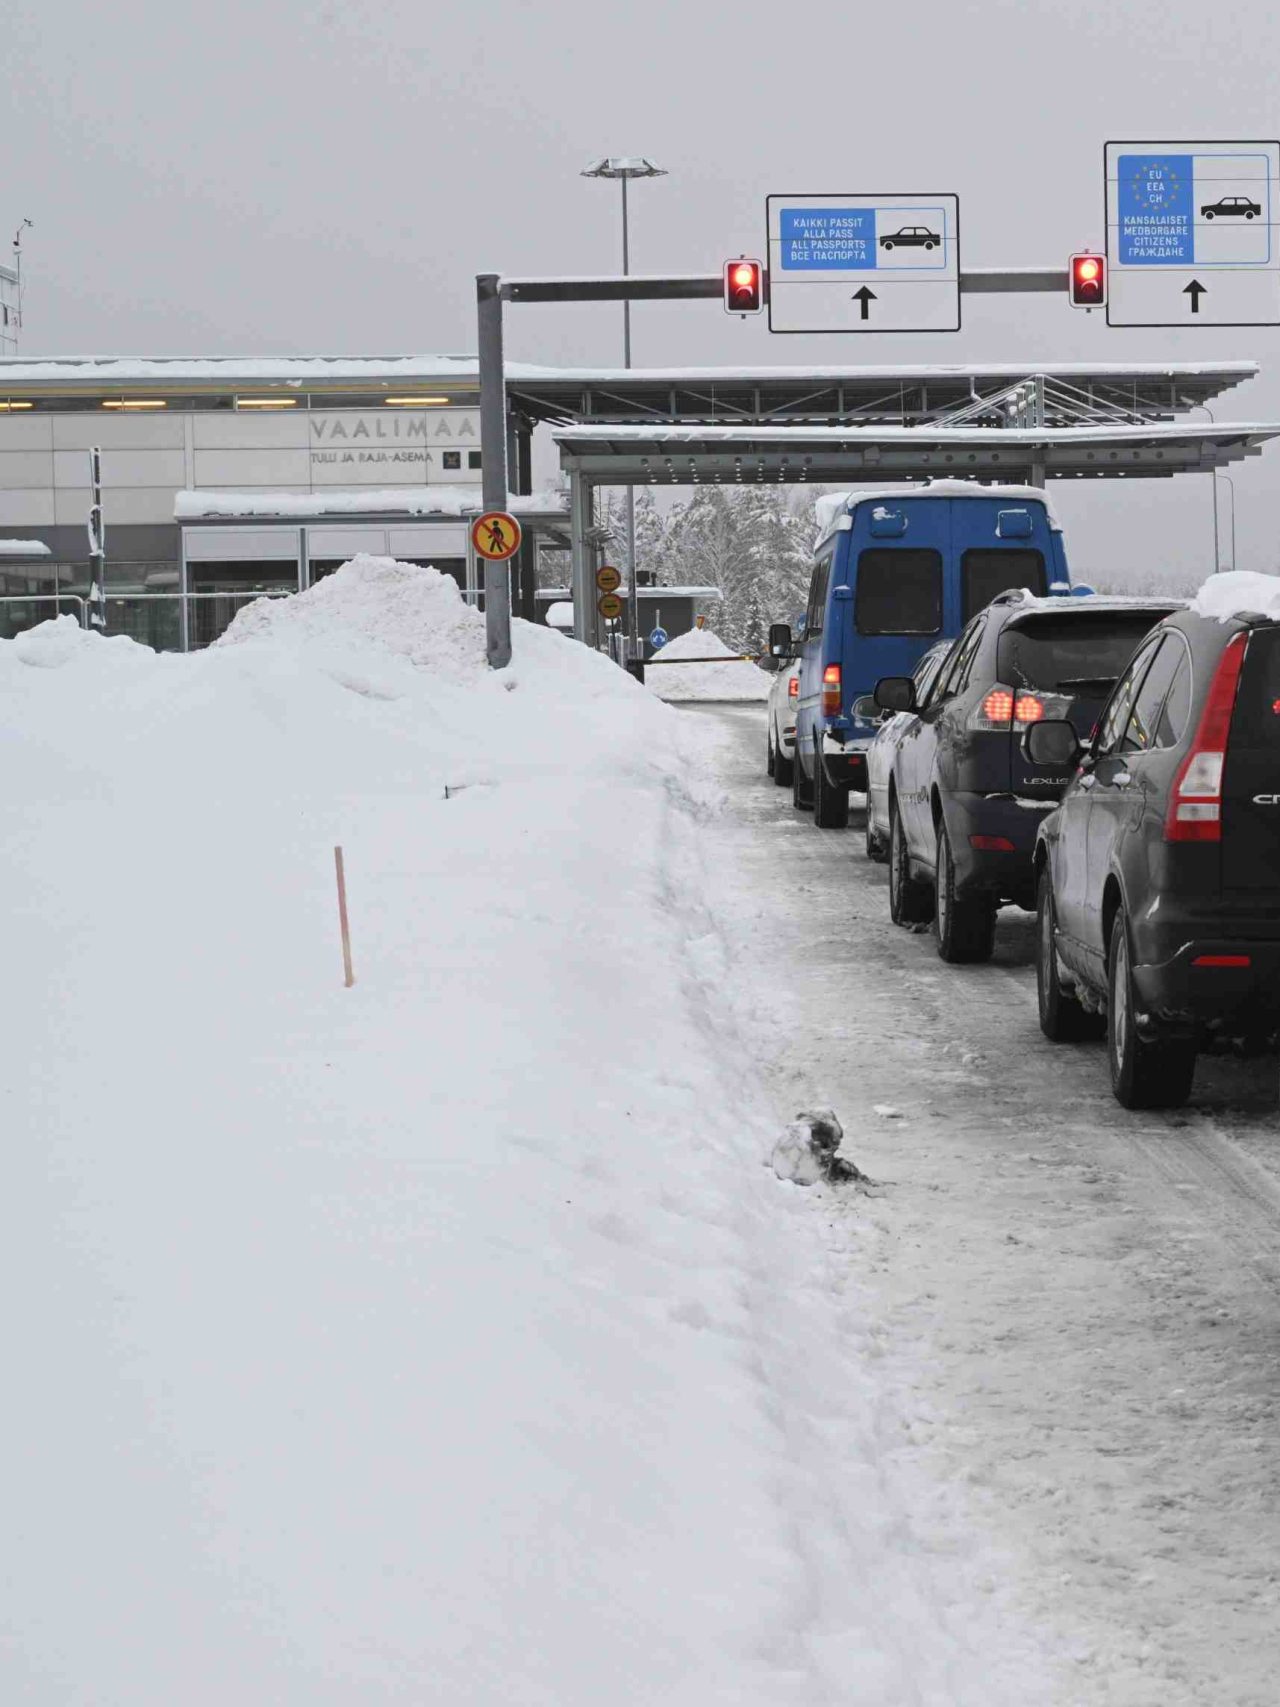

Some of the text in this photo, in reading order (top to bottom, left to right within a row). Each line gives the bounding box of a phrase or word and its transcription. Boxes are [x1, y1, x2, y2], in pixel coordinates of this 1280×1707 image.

[1149, 170, 1162, 180] EU
[1146, 182, 1165, 191] EEA
[1149, 194, 1162, 203] CH
[793, 218, 863, 228] KAIKKI PASSIT
[1124, 216, 1187, 225] KANSALAISET
[804, 229, 853, 238] ALLA PASS
[1124, 226, 1188, 236] MEDBORGARE
[791, 240, 866, 249] ALL PASSPORTS
[1134, 237, 1179, 246] CITIZENS
[791, 251, 866, 260] ВСЕ ПАСПОРТА
[1128, 247, 1184, 257] ГРАЖДАНЕ
[310, 418, 476, 439] VAALIMAA
[312, 452, 433, 464] TULLI JA RAJA-ASEMA
[1023, 777, 1069, 785] LEXUS
